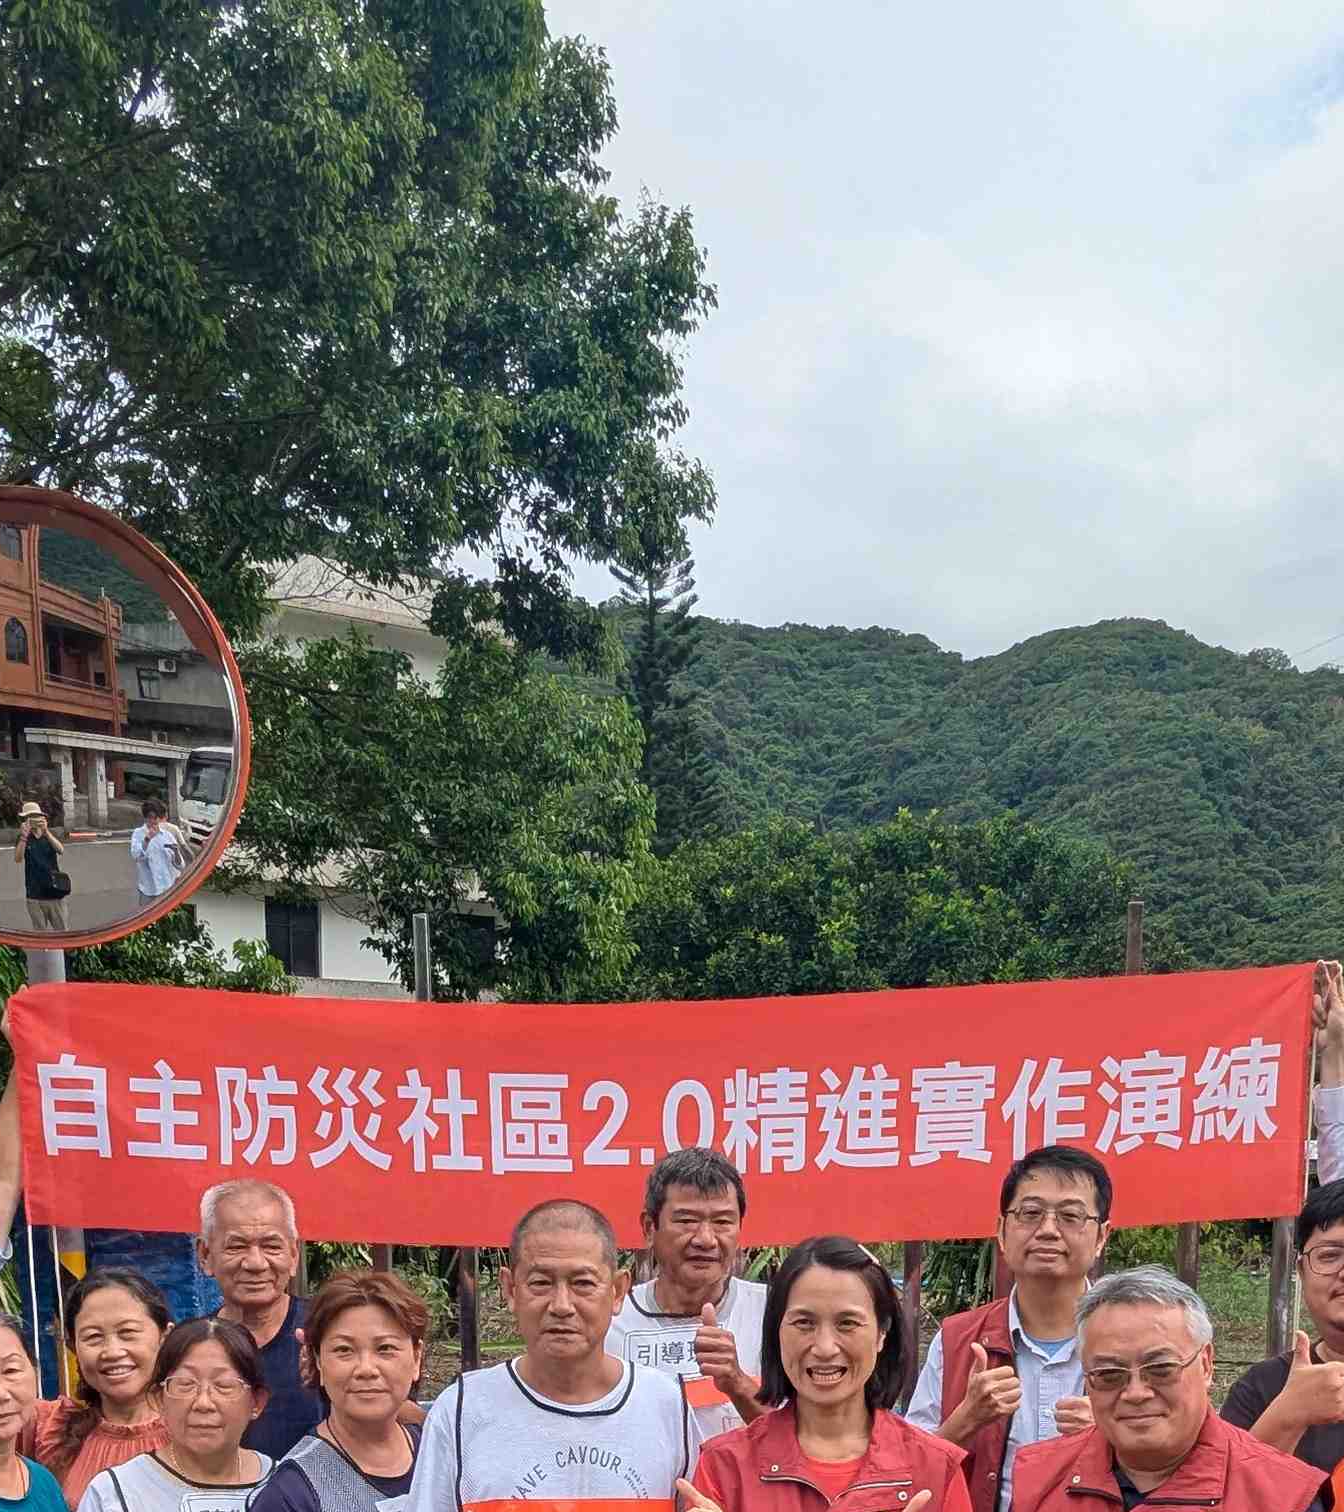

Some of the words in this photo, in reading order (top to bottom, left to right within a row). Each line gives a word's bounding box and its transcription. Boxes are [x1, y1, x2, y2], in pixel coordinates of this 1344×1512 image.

[36, 1035, 1283, 1177] 自主防災社區2.0精進實作演練
[555, 1445, 622, 1474] CAVOUR
